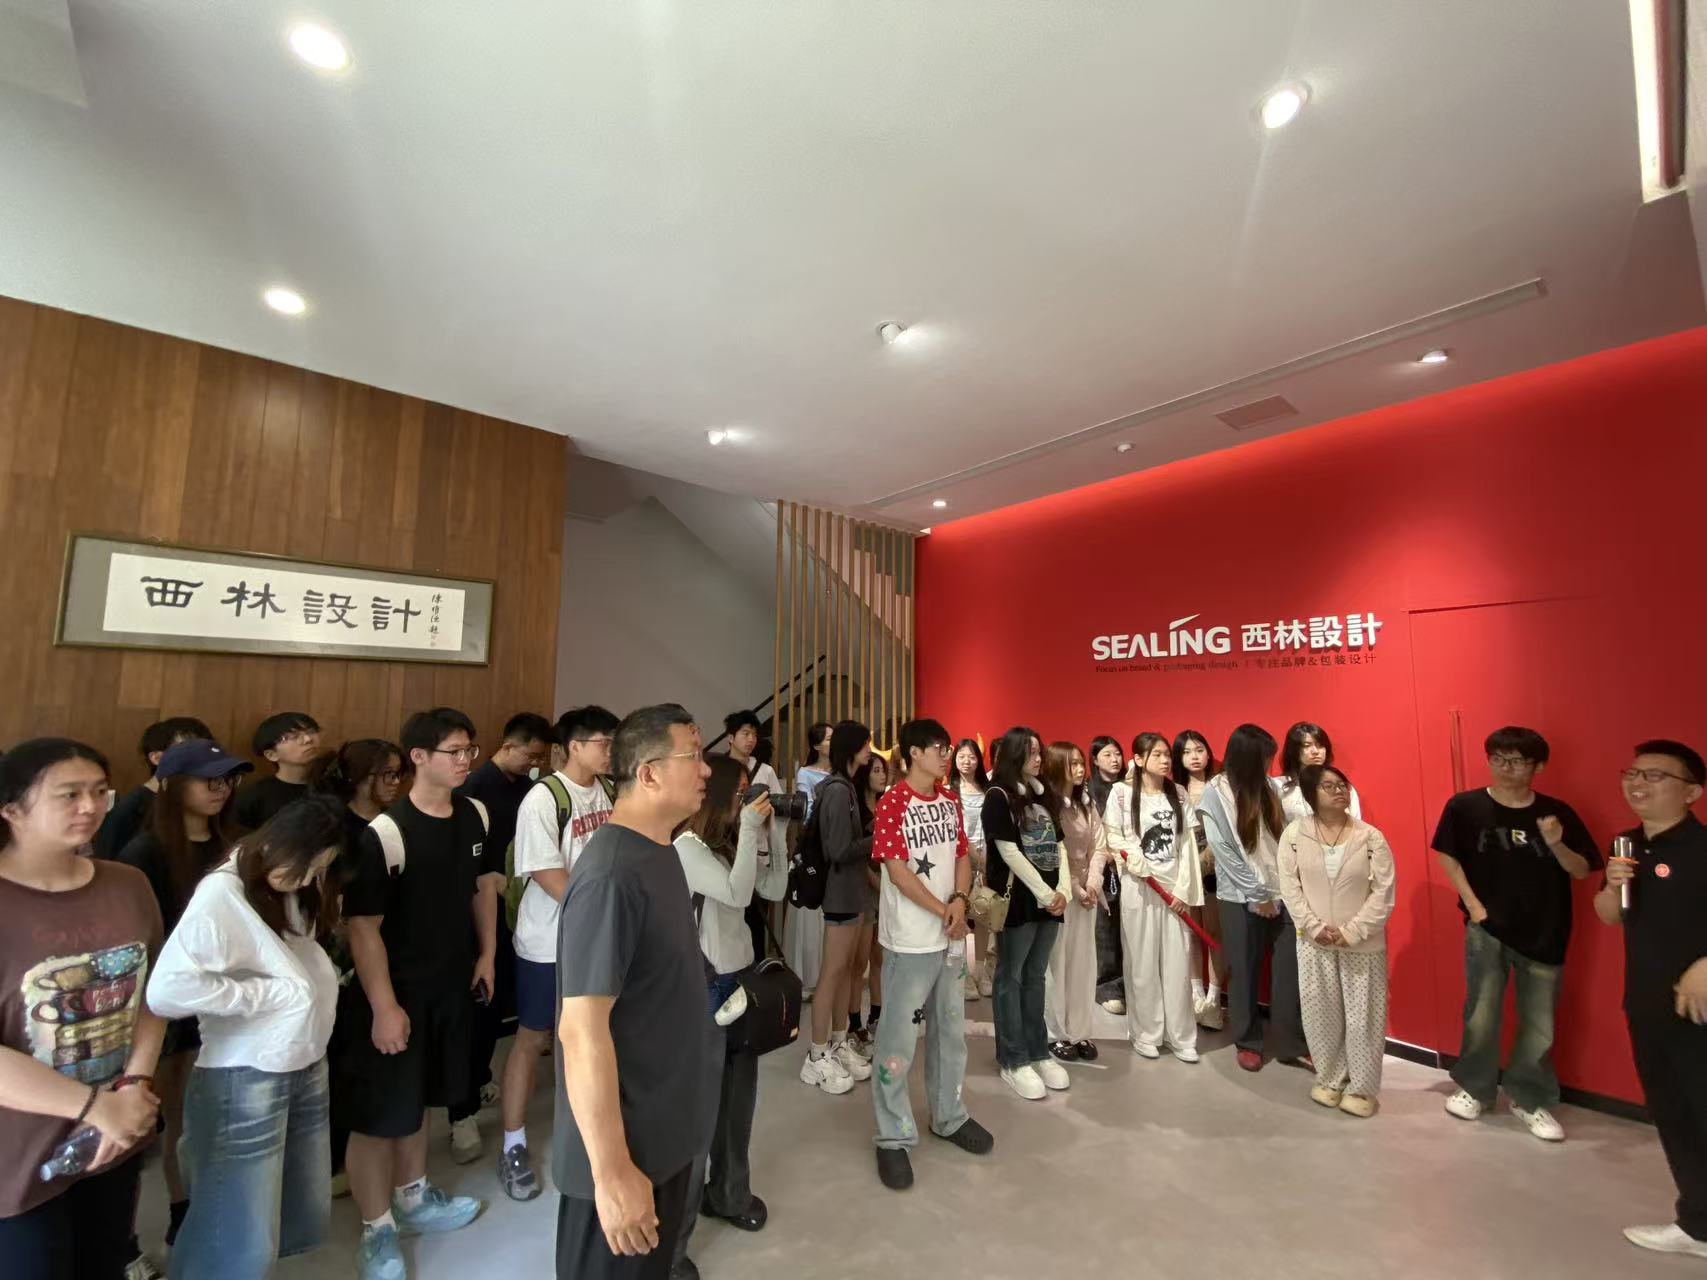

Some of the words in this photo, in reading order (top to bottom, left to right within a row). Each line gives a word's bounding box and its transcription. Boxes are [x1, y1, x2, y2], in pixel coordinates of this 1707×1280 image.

[140, 575, 422, 634] 西林設計
[1091, 613, 1231, 661] SEALING
[1240, 612, 1383, 653] 西林設計
